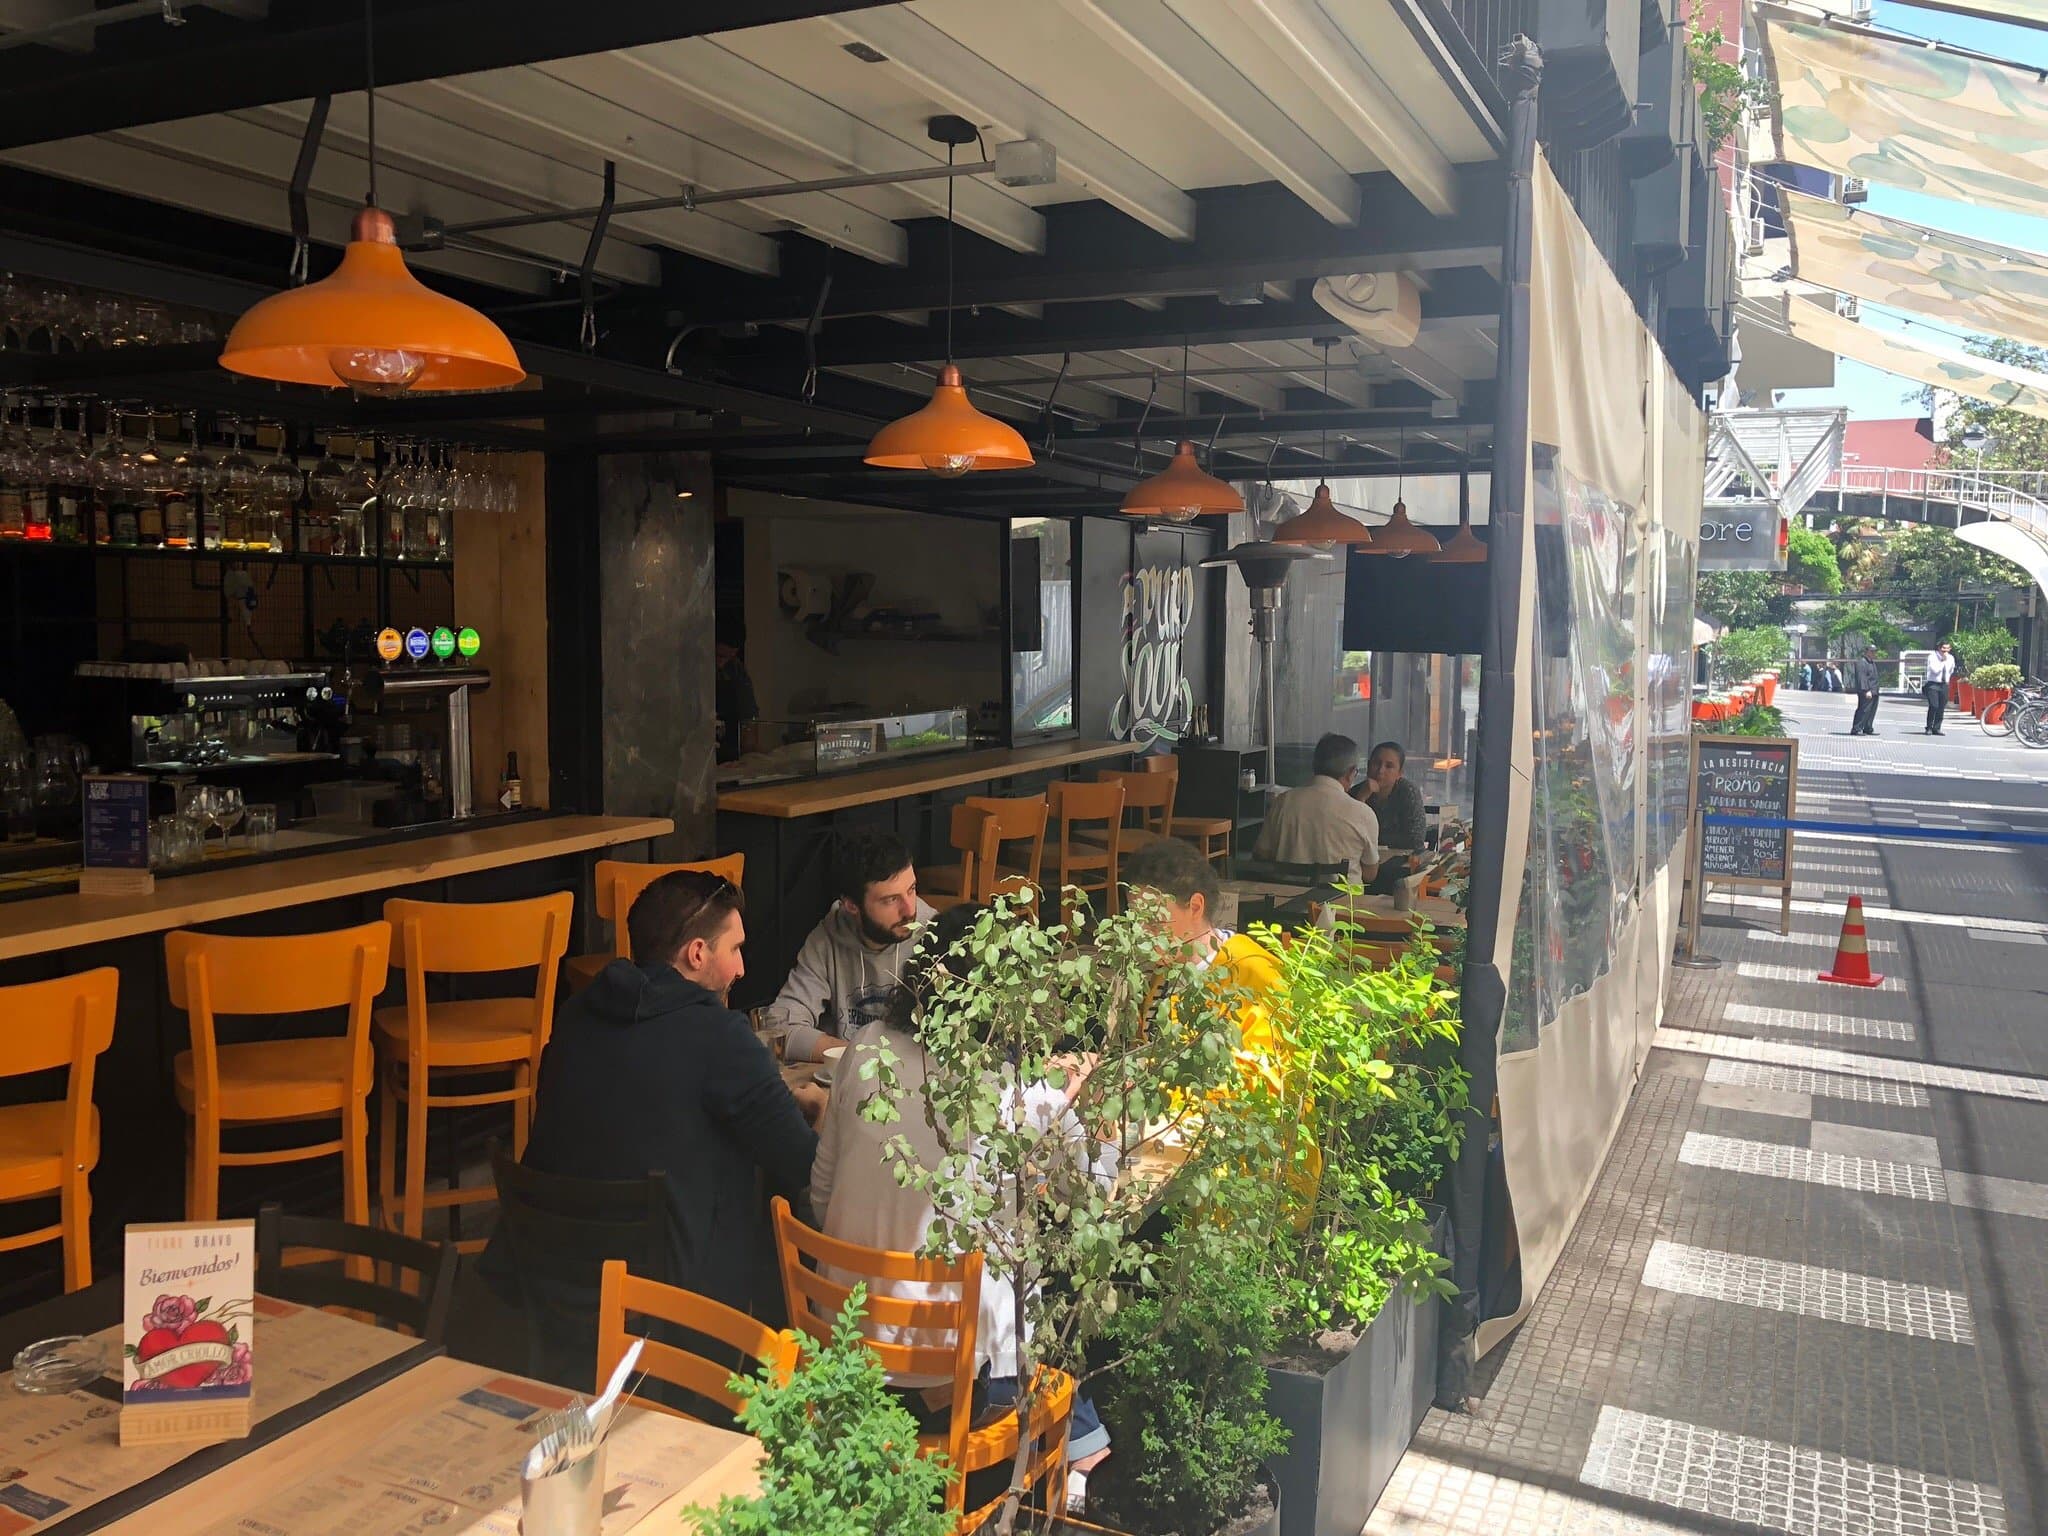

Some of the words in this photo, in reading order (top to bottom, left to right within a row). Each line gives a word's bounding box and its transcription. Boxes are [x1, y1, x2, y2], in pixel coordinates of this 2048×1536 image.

[1703, 758, 1715, 769] LA
[1719, 757, 1785, 774] RESISTENCIA
[1714, 776, 1761, 793] PROMO
[1753, 838, 1776, 849] BRUT
[1704, 861, 1738, 870] AUVIGNON
[193, 1233, 232, 1249] BRAVO
[139, 1252, 240, 1287] Bienvenidos!
